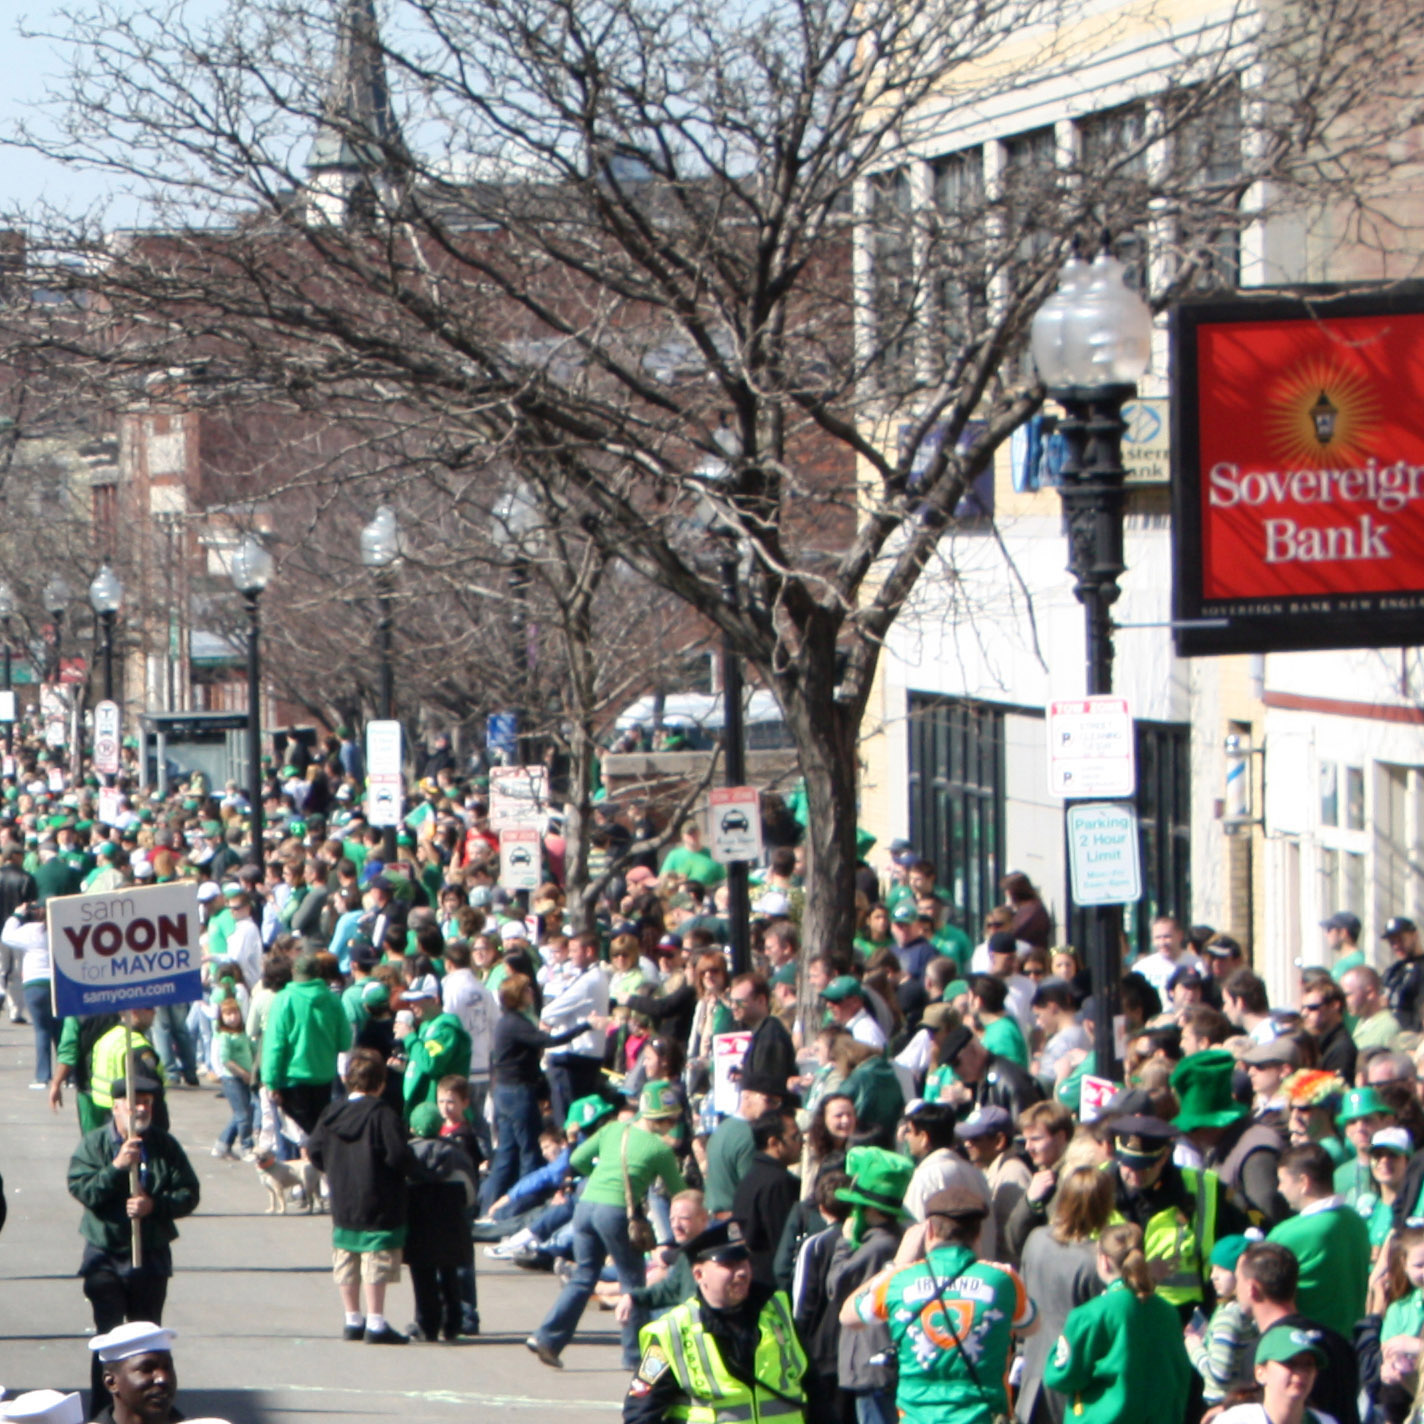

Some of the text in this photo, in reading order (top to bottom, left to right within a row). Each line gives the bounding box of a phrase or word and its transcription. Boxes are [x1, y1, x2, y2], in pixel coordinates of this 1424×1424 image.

[1263, 514, 1392, 563] Bank
[1201, 604, 1283, 616] SOVEREIGN
[1290, 602, 1331, 613] BANK
[1339, 600, 1372, 611] NEW
[1076, 816, 1129, 831] Parking
[1080, 833, 1127, 847] 2 Hour
[1086, 850, 1122, 863] Limit
[81, 899, 134, 922] sam
[63, 913, 189, 959] YOON
[81, 950, 190, 981] for MAYOR
[83, 982, 176, 1003] samyoon.com
